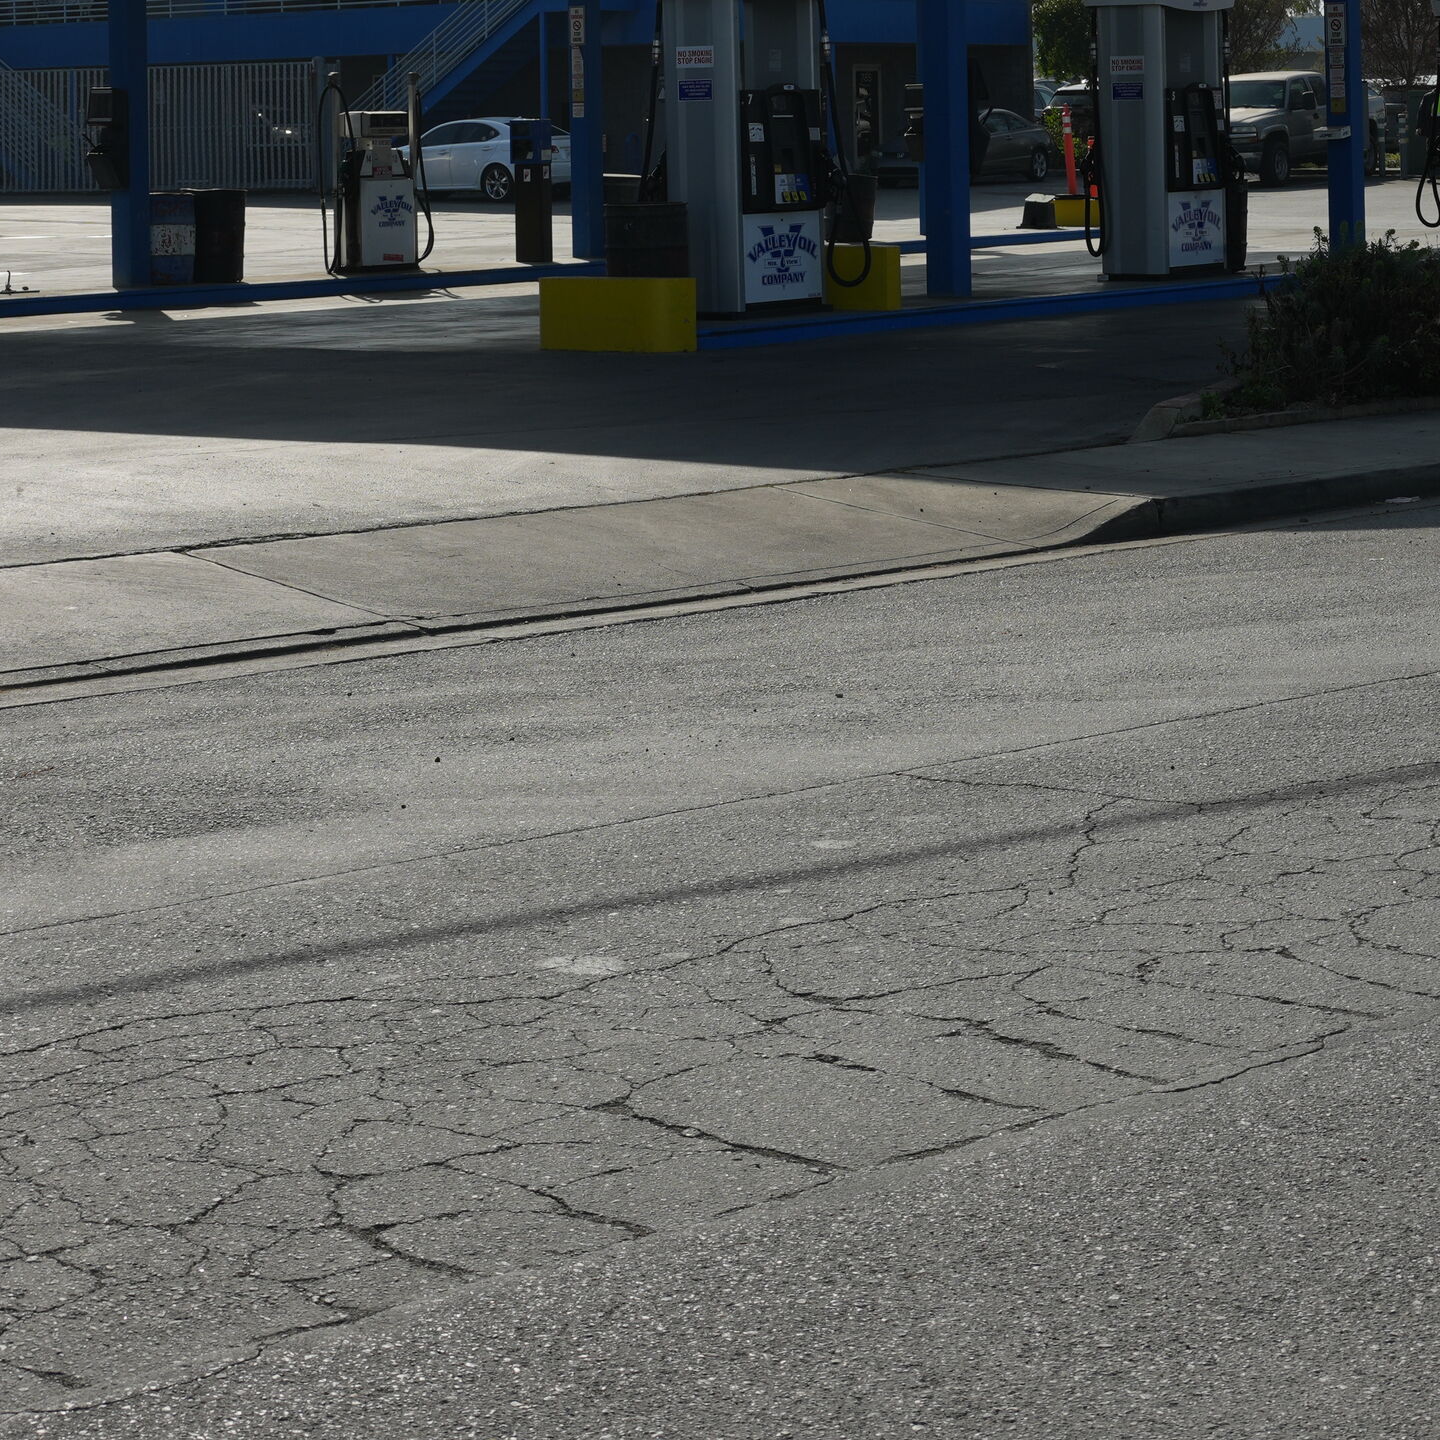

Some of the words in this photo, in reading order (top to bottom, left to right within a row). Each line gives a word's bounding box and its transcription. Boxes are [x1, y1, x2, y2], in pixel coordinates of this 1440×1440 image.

[688, 49, 712, 57] SMOKING
[747, 93, 753, 105] 7
[746, 234, 794, 263] VALLEY
[798, 235, 818, 260] OIL
[762, 271, 807, 286] COMPANY
